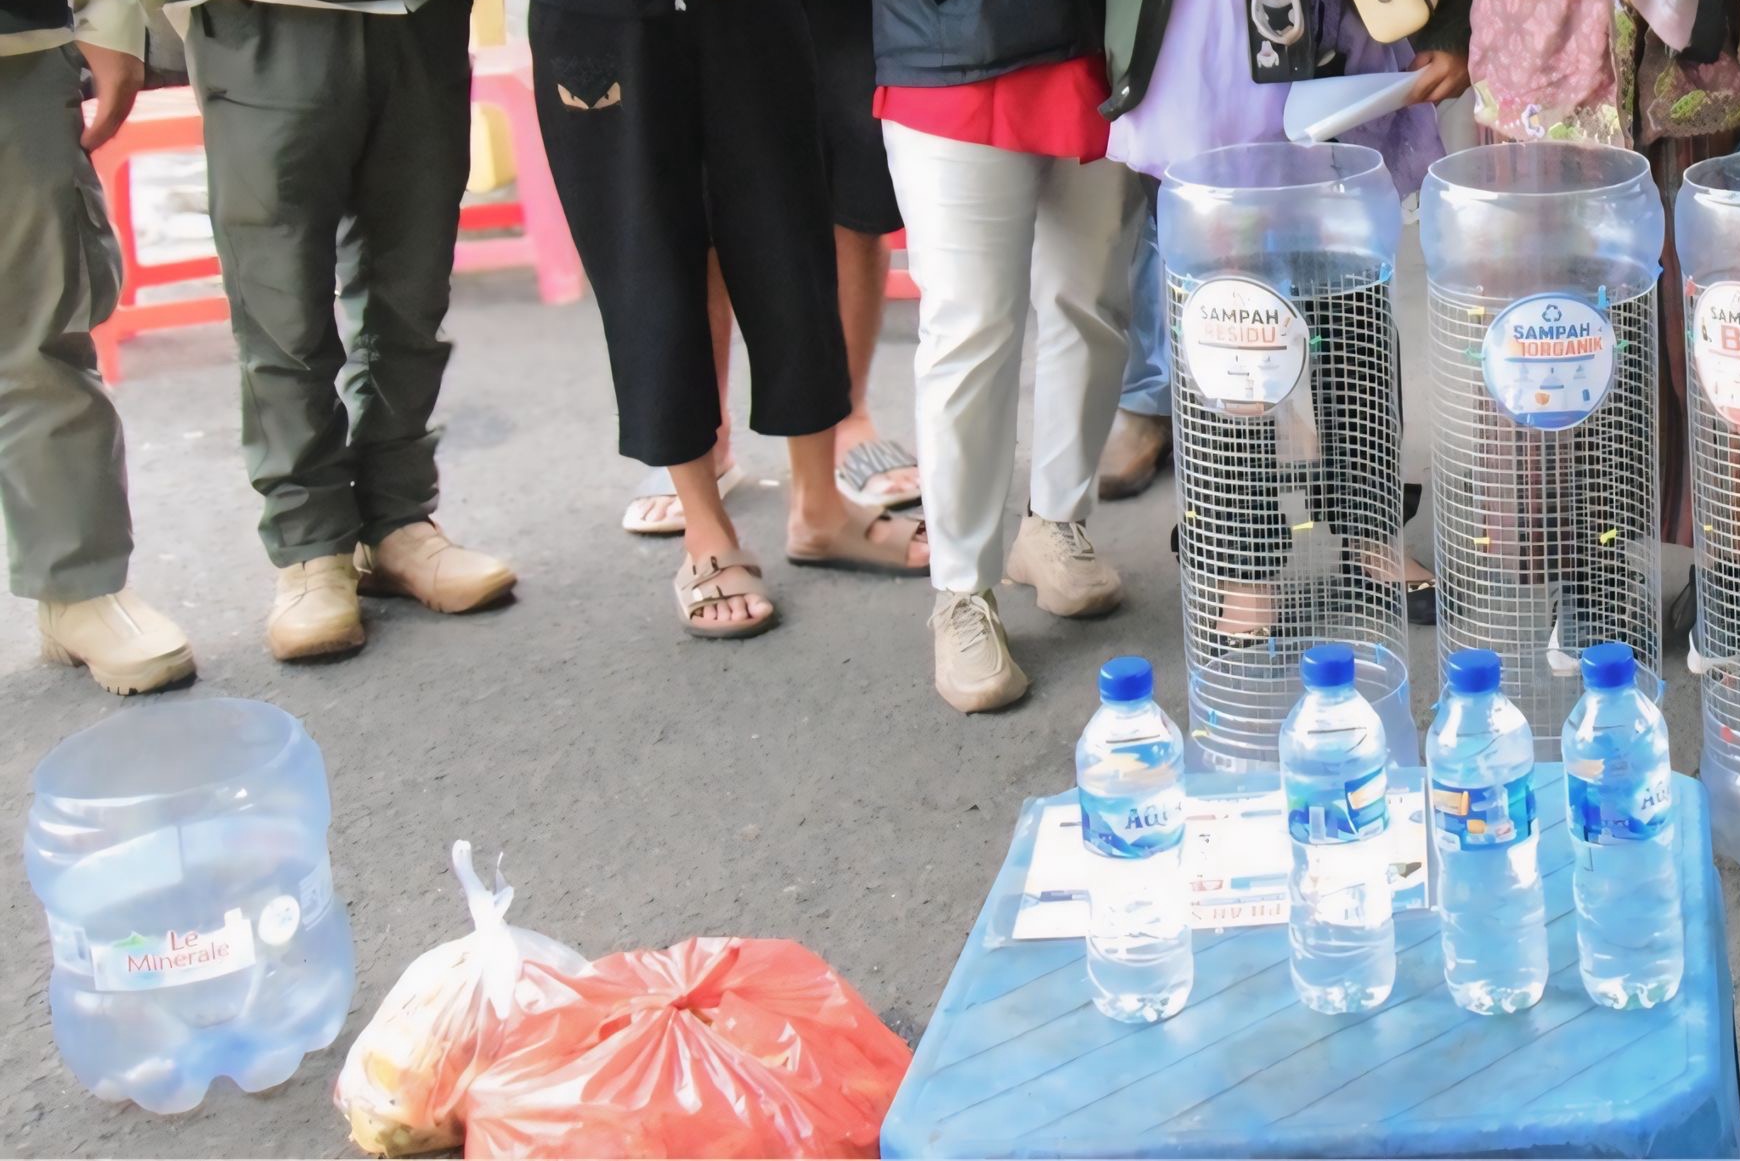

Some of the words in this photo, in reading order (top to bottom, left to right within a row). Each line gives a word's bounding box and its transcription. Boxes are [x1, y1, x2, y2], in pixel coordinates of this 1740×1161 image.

[1200, 305, 1279, 325] SAMPAH
[1513, 322, 1590, 340] SAMPAH
[170, 930, 199, 952] Le
[127, 942, 231, 973] Minerale
